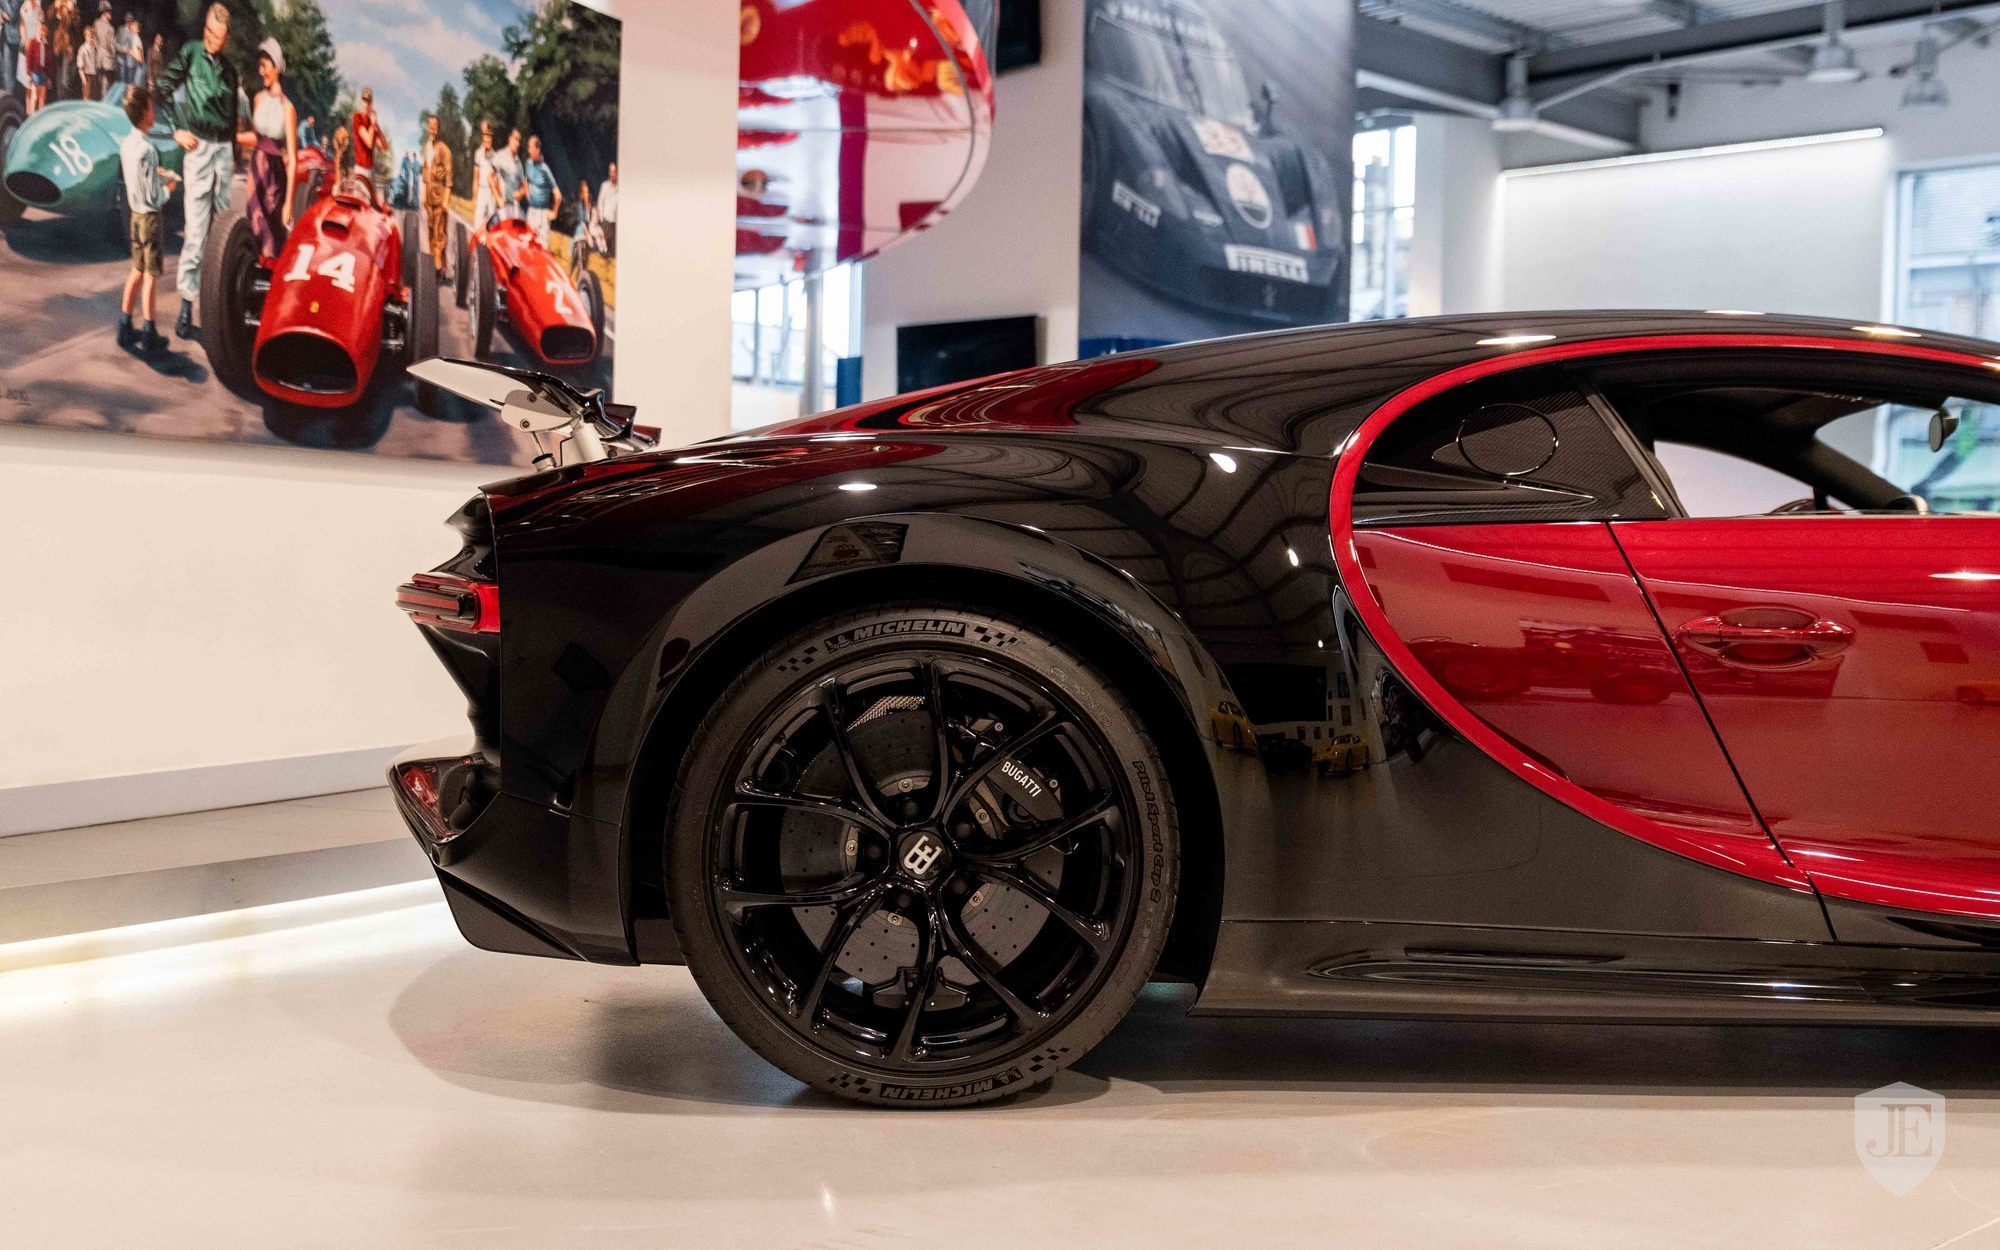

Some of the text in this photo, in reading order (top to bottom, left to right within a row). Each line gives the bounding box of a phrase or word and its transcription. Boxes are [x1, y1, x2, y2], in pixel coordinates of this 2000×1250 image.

[48, 134, 94, 176] 18
[283, 244, 356, 294] 14
[852, 619, 966, 642] MICHELIN
[1001, 761, 1042, 797] BUGATTI
[883, 1078, 993, 1099] MICHELIN
